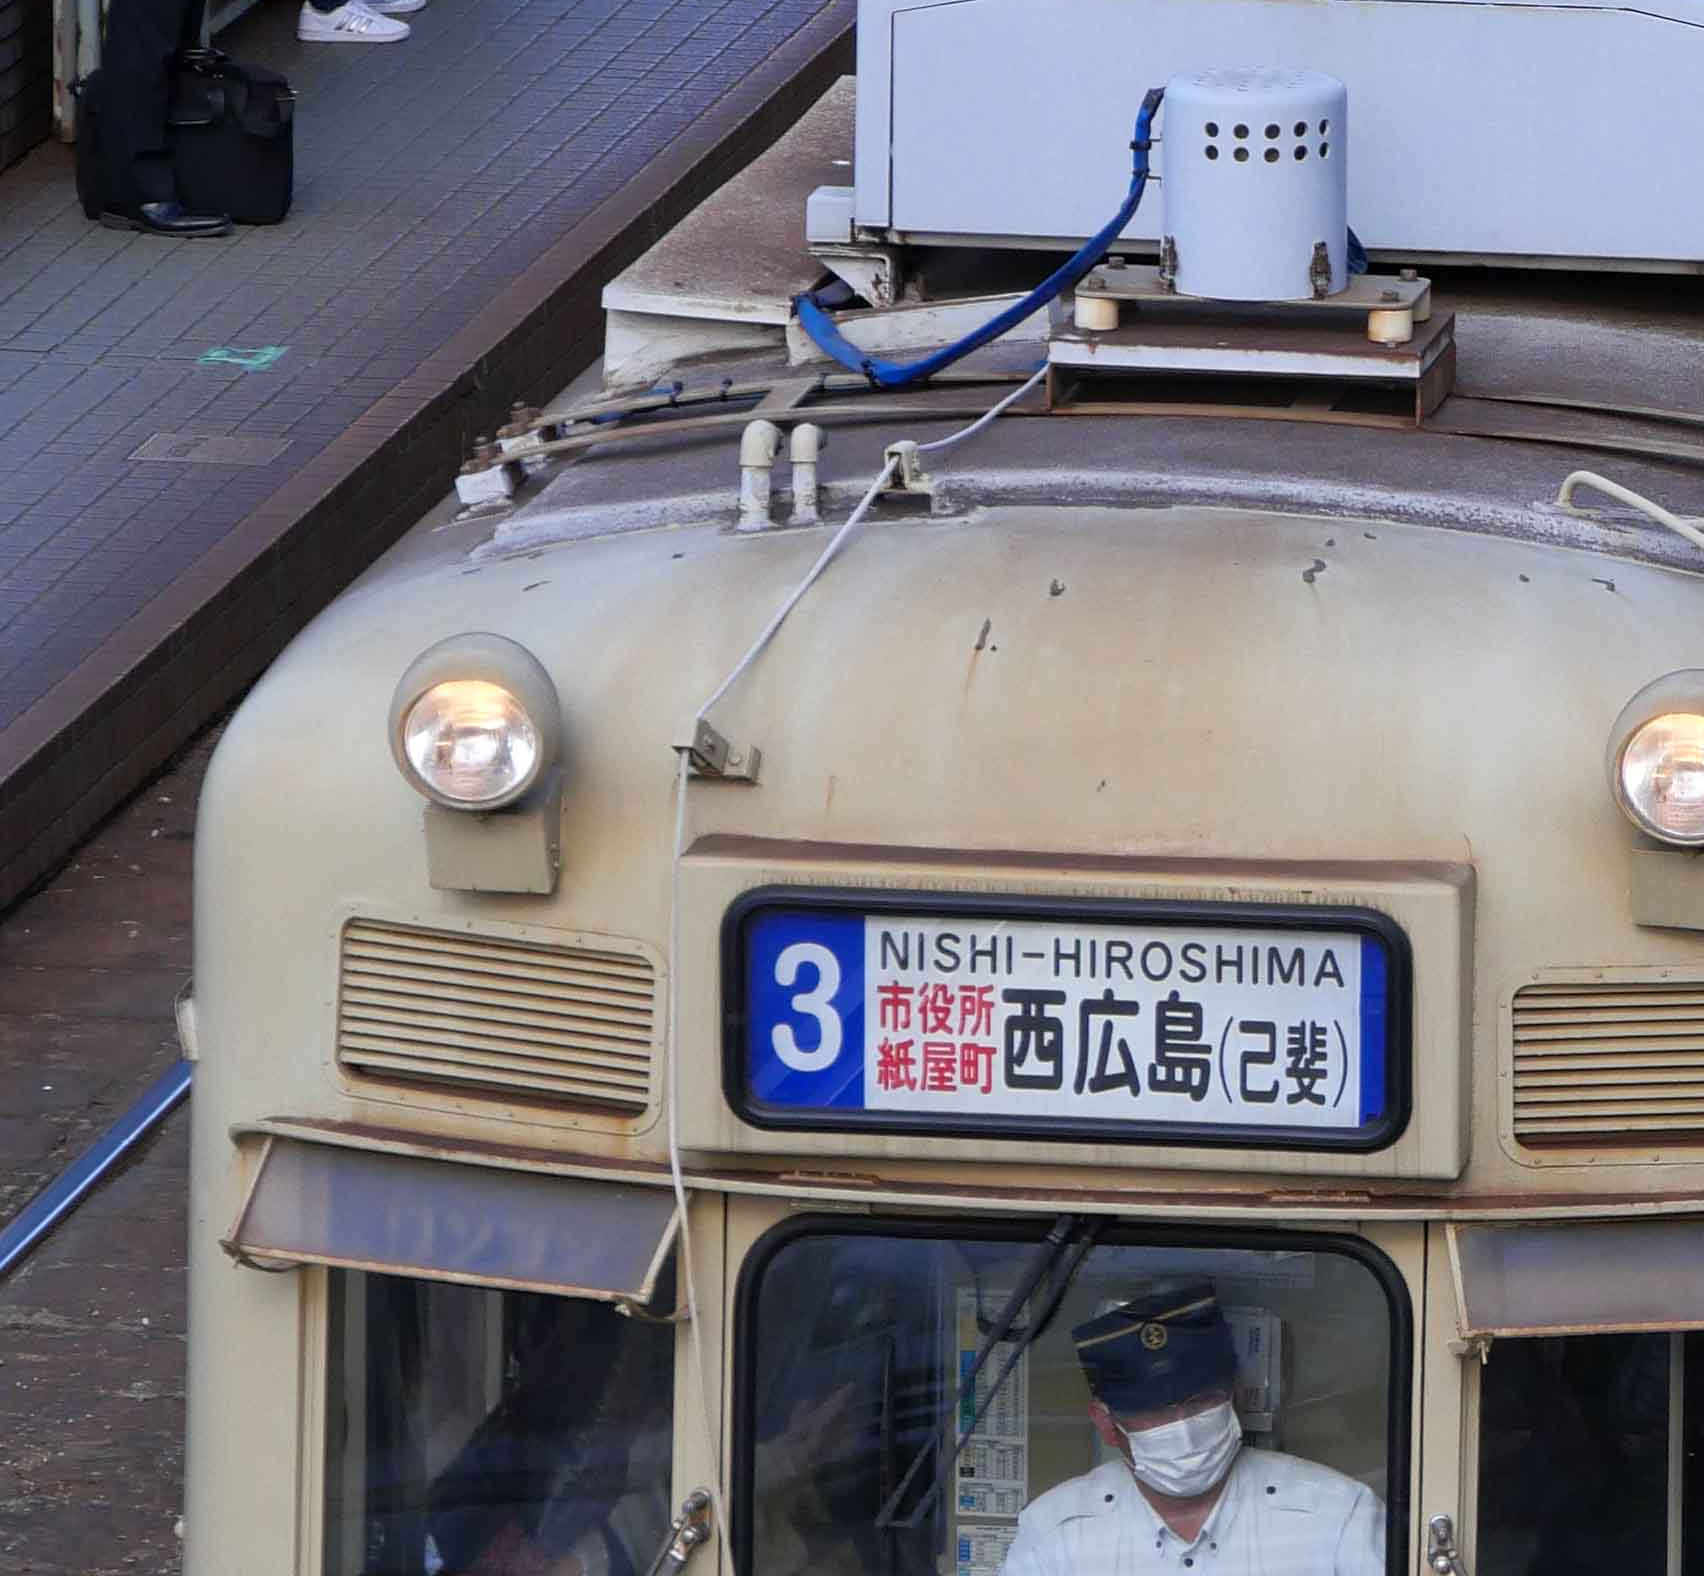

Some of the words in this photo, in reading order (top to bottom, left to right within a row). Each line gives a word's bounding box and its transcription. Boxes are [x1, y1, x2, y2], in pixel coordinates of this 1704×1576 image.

[880, 930, 1345, 988] NISHI-HIROSHIMA
[771, 943, 842, 1072] 3
[876, 979, 994, 1037] 市役所
[876, 1037, 998, 1094] 紙屋町
